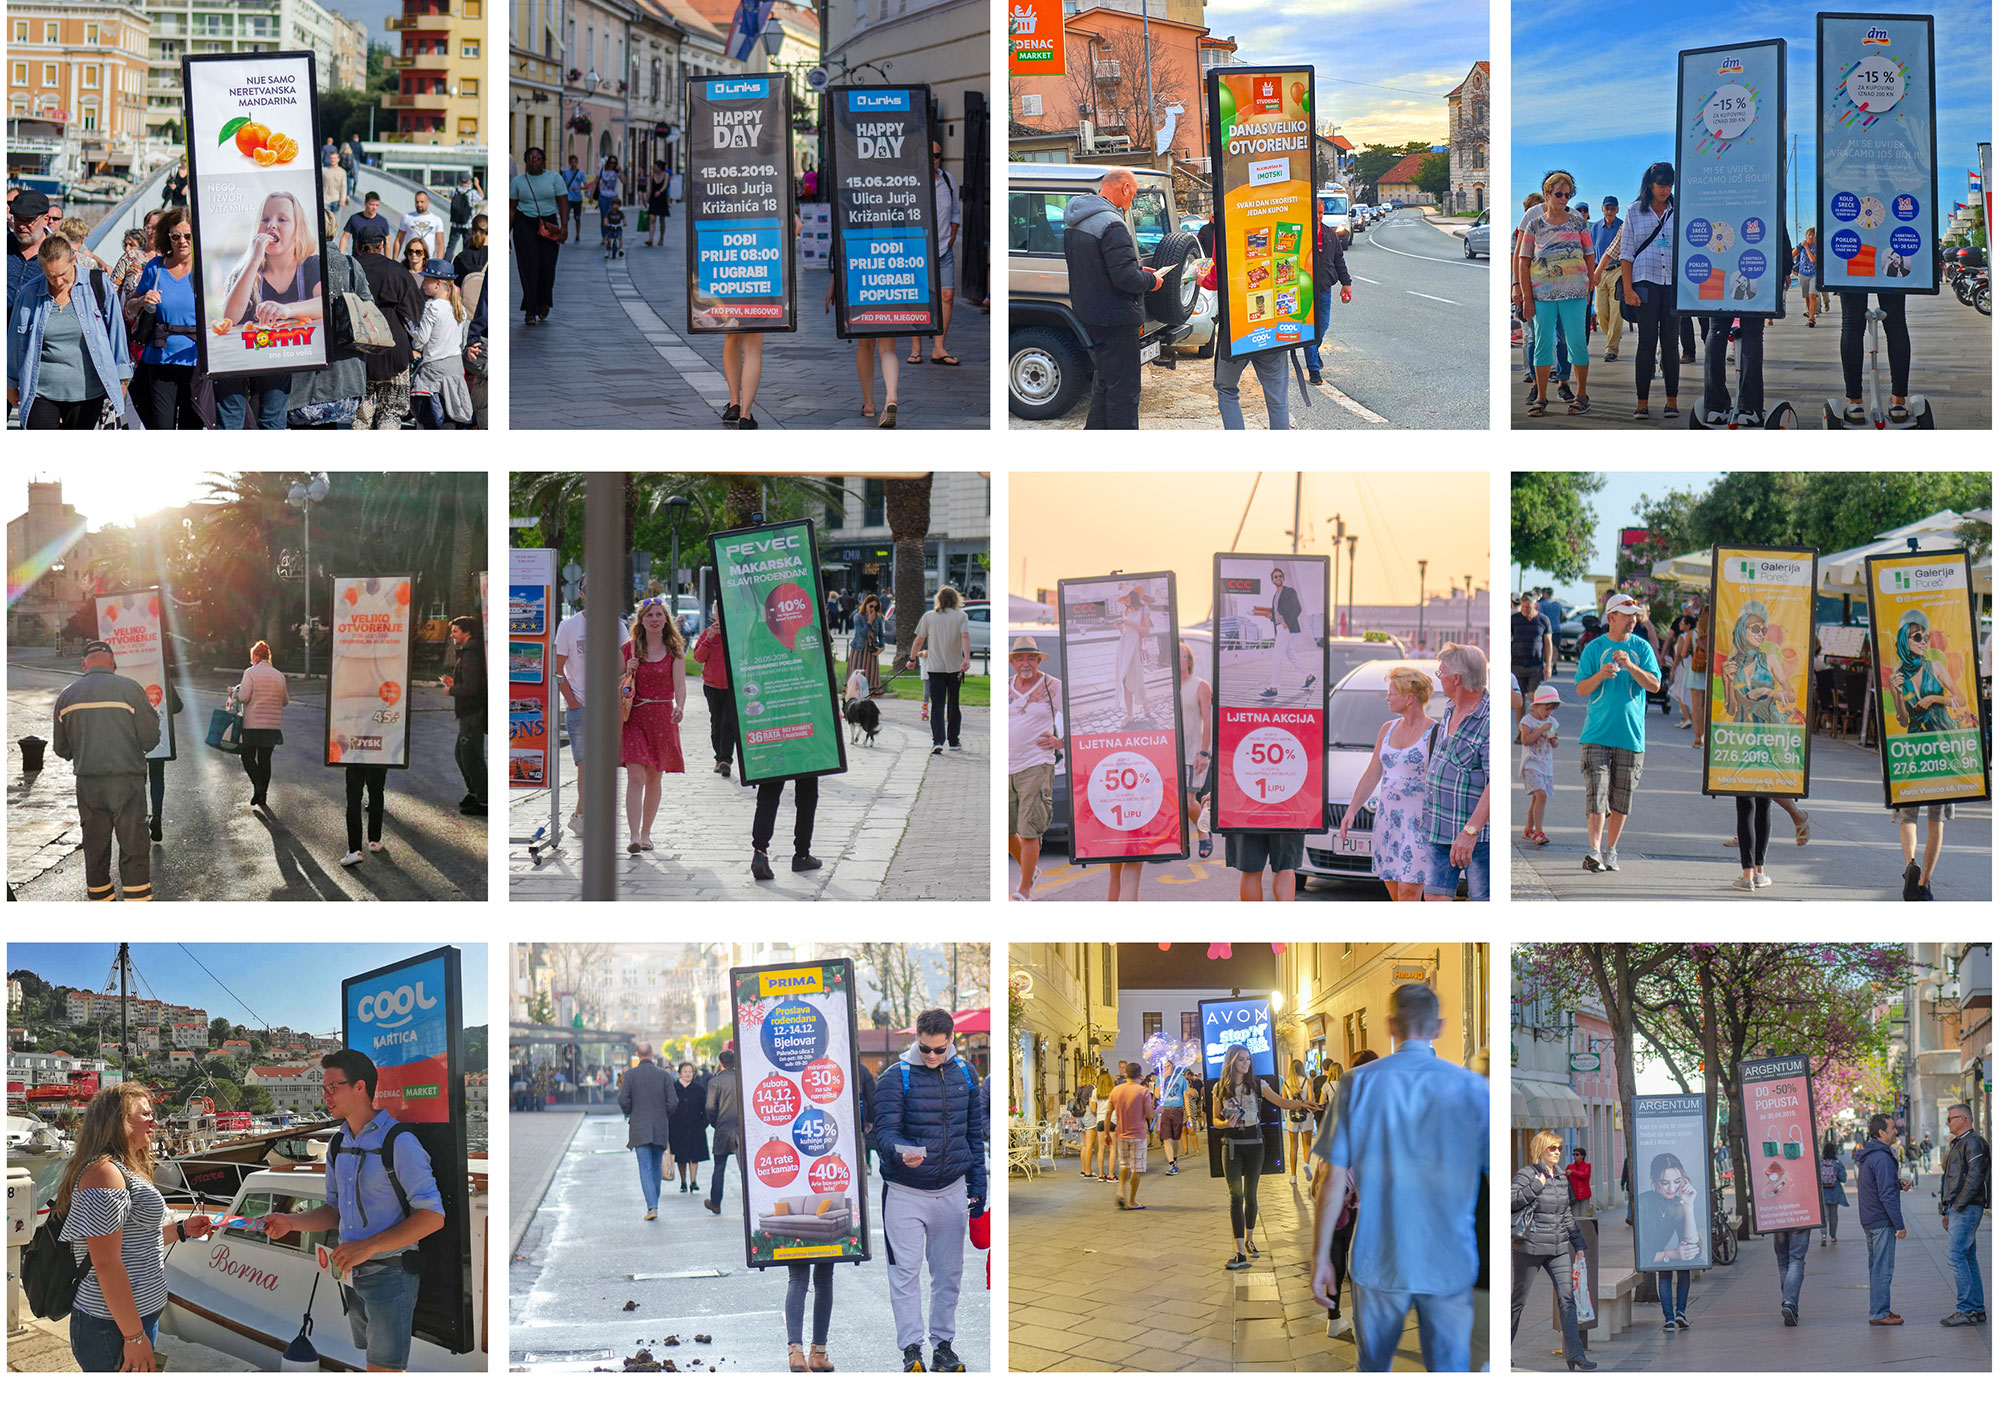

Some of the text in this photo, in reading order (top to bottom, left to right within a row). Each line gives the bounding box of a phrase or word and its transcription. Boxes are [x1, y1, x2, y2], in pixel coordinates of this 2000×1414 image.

[1867, 28, 1887, 39] dm
[1019, 52, 1051, 60] MARKET
[1722, 57, 1740, 68] dm
[246, 75, 296, 85] NIJE SAMO
[1858, 71, 1879, 83] -15
[229, 86, 297, 97] NERETVANSKA
[238, 97, 297, 107] MANDARINA
[1713, 99, 1732, 111] -15
[713, 110, 763, 126] HAPPY
[856, 123, 905, 137] HAPPY
[1228, 120, 1307, 137] DANAS VELIKO
[713, 124, 763, 149] DAY
[857, 136, 905, 159] DAY
[1229, 136, 1308, 155] OTVORENJE!
[1875, 140, 1905, 148] UVIJEK
[701, 165, 778, 179] 15.06.2019.
[1257, 170, 1283, 180] IMOTSKI
[1727, 165, 1756, 174] UVIJEK
[846, 176, 921, 188] 15.06.2019.
[706, 181, 773, 197] Ulica Jurja
[852, 191, 916, 206] Ulica Jurja
[1236, 201, 1255, 209] SVAKI
[1270, 196, 1298, 205] ISKORISTI
[209, 204, 256, 214] VITAMINA
[702, 199, 777, 214] Križanića 18
[1246, 206, 1289, 216] JEDAN KUPON
[849, 209, 921, 223] Križanića 18
[723, 234, 757, 246] DOĐI
[701, 248, 779, 262] PRIJE 08:00
[871, 242, 903, 255] DOĐI
[849, 257, 925, 270] PRIJE 08:00
[713, 265, 768, 279] I UGRABI
[862, 273, 915, 286] I UGRABI
[710, 281, 771, 294] POPUSTE!
[860, 288, 919, 302] POPUSTE!
[711, 307, 779, 316] TKO PRVI, NJEGOVO!
[875, 314, 892, 322] PRVI,
[893, 313, 927, 321] NJEGOVO!
[241, 327, 316, 350] TOMMY
[1252, 333, 1271, 343] COOL
[269, 346, 313, 359] zna što voliš
[725, 535, 801, 559] PEVEC
[729, 555, 803, 576] MAKARSKA
[1761, 562, 1801, 574] Galerija
[727, 567, 808, 588] SLAVI ROĐENDAN!
[1760, 572, 1789, 582] Poreč
[1915, 567, 1955, 579] Galerija
[1228, 579, 1252, 590] CCC
[1915, 578, 1944, 589] Poreč
[778, 598, 806, 613] 10%
[1073, 603, 1097, 614] CCC
[351, 613, 390, 624] VELIKO
[113, 625, 146, 637] VELIKO
[338, 623, 404, 633] OTVORENJE
[105, 633, 158, 645] OTVORENJE
[1227, 713, 1315, 724] LJETNA AKCIJA
[748, 731, 763, 744] 36
[763, 730, 781, 741] RATA
[792, 724, 811, 732] KAMATE
[786, 730, 808, 738] NAKNADE
[1714, 728, 1801, 752] Otvorenje
[357, 739, 381, 747] JYSK
[1079, 735, 1169, 750] LJETNA AKCIJA
[1890, 737, 1977, 758] Otvorenje
[1714, 749, 1772, 763] 27.6.2019.
[1893, 758, 1950, 775] 27.6.2019.
[1718, 776, 1737, 784] Mate
[1957, 782, 1979, 791] Poreč
[1255, 778, 1267, 799] 1
[1110, 804, 1142, 827] 1 LIPU
[1342, 839, 1357, 851] PU
[768, 975, 816, 988] PRIMA
[358, 981, 437, 1023] COOL
[776, 1006, 811, 1015] Proslava
[1206, 1003, 1269, 1025] AVON
[771, 1015, 817, 1026] rođendana
[773, 1024, 815, 1036] 12.-14.12.
[373, 1030, 418, 1048] KARTICA
[774, 1035, 817, 1050] Bjelovar
[1745, 1061, 1802, 1077] ARGENTUM
[762, 1079, 788, 1088] subota
[805, 1070, 841, 1086] -30%
[406, 1087, 437, 1097] MARKET
[757, 1089, 796, 1102] 14.12.
[811, 1093, 837, 1101] namještaj
[1755, 1083, 1797, 1098] DO -50%
[761, 1101, 794, 1115] ručak
[1638, 1100, 1700, 1111] ARGENTUM
[1755, 1096, 1799, 1111] POPUSTA
[772, 1113, 792, 1122] kupce
[794, 1119, 837, 1137] -45%
[760, 1155, 794, 1166] 24 rate
[757, 1163, 799, 1176] bez kamata
[809, 1163, 849, 1180] -40%
[8, 1186, 15, 1198] 8
[209, 1243, 279, 1292] Borna
